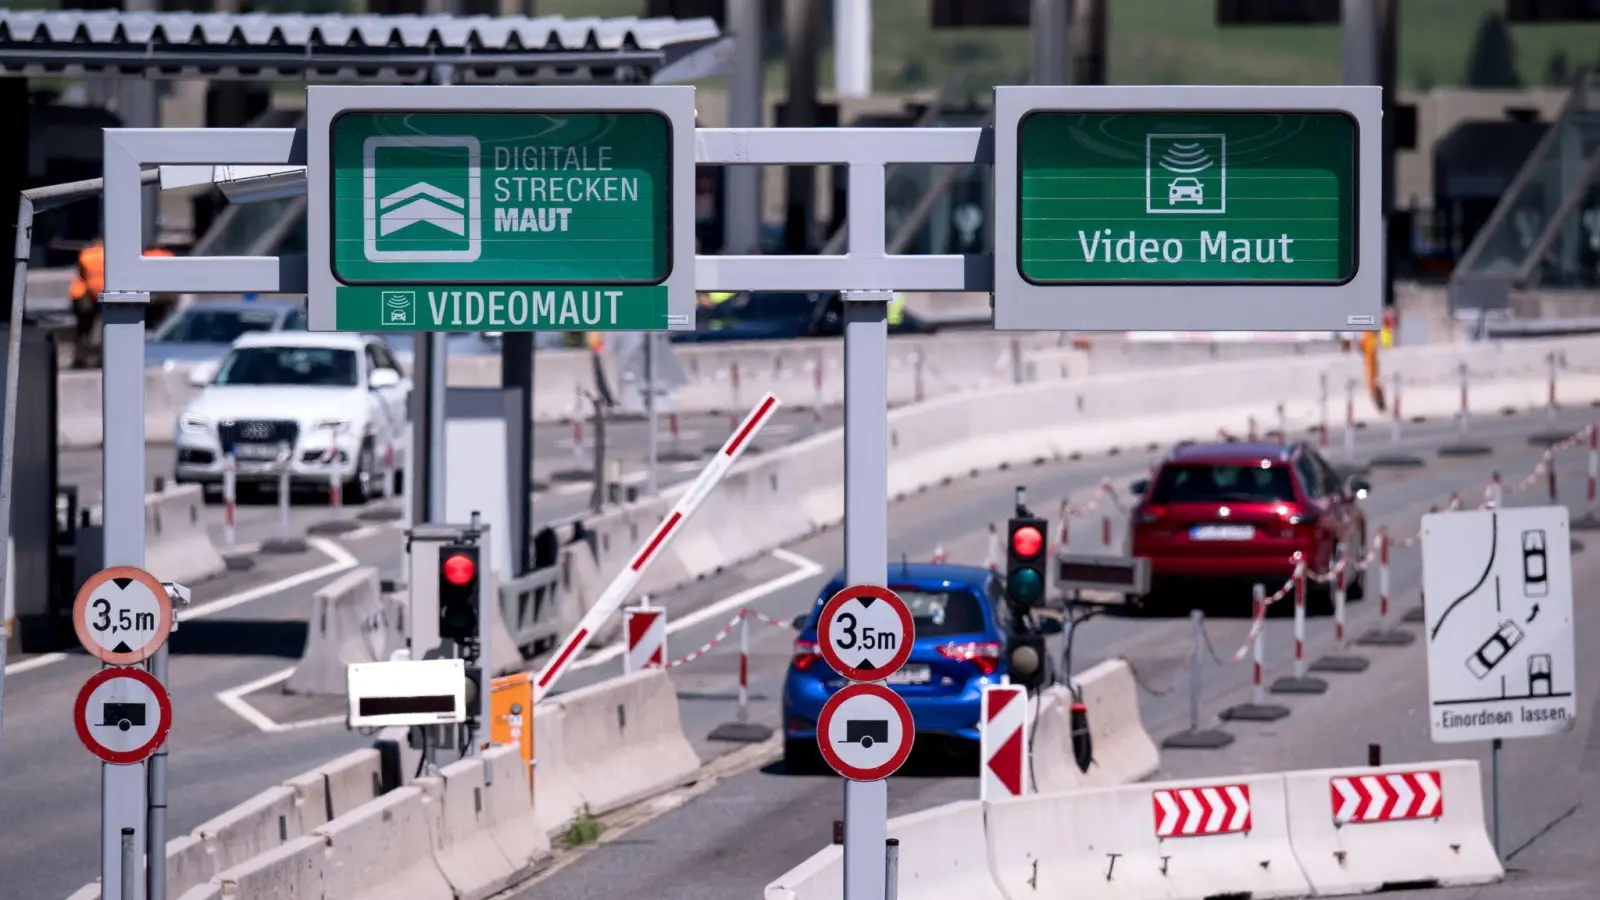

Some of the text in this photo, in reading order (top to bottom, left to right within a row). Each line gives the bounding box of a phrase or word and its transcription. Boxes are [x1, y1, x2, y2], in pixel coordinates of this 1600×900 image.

[494, 146, 613, 171] DIGITALE
[494, 176, 638, 202] STRECKEN
[494, 207, 573, 232] MAUT
[1078, 228, 1295, 264] Video Maut
[427, 290, 624, 325] VIDEOMAUT
[1441, 705, 1567, 729] Einordnen lassen
